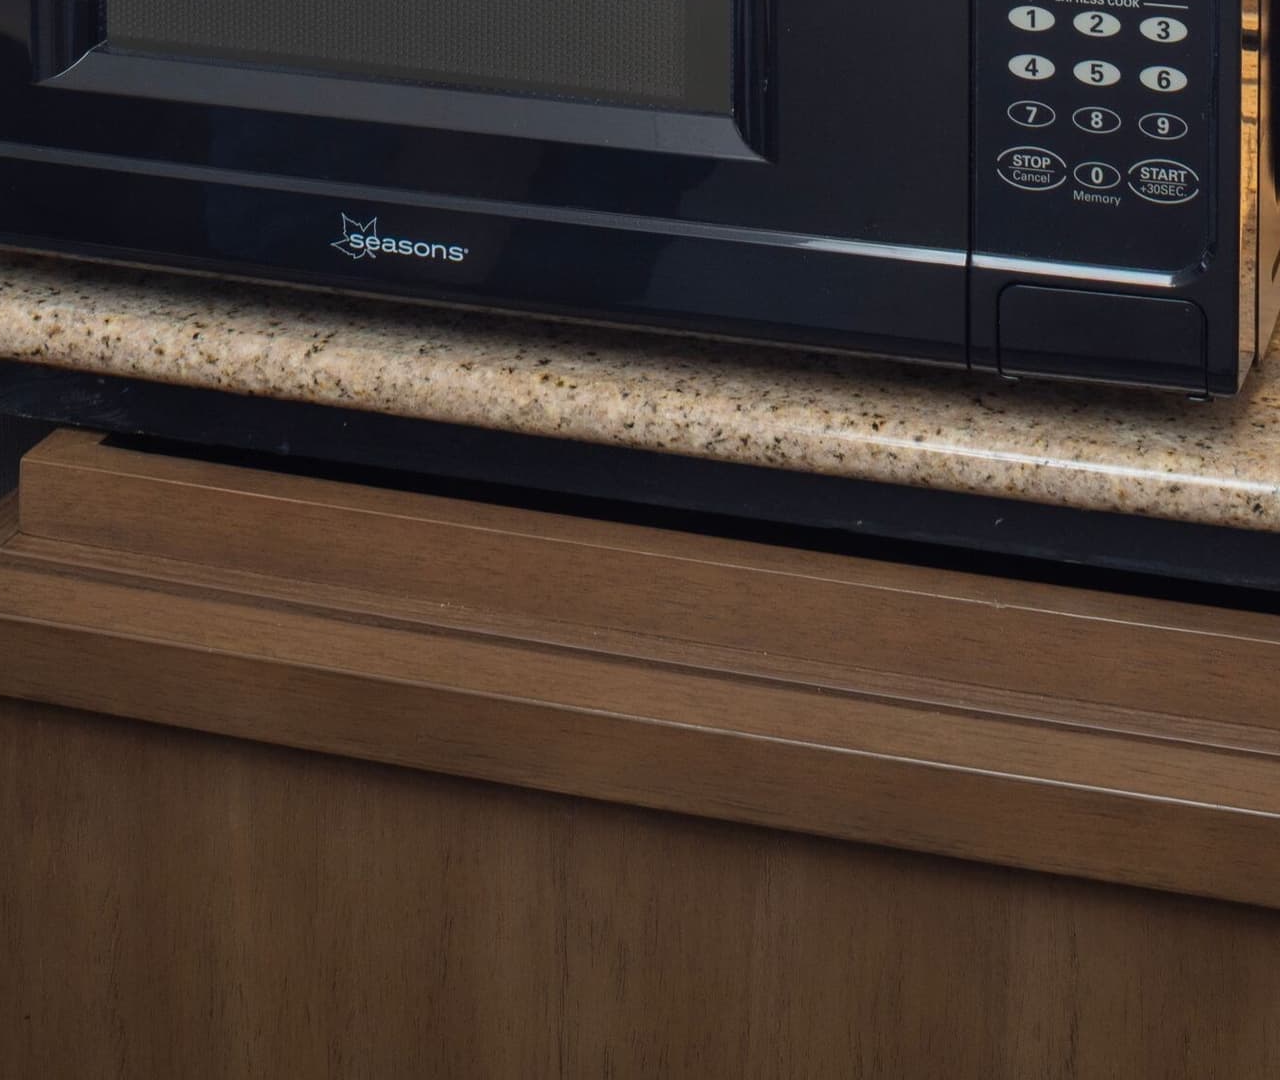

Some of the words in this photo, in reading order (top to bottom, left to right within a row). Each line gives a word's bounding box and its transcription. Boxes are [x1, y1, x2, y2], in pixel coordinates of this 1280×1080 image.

[1026, 9, 1036, 28] 1
[1090, 14, 1104, 33] 2
[1156, 20, 1170, 40] 3
[1025, 58, 1038, 77] 4
[1090, 63, 1104, 83] 5
[1157, 70, 1171, 90] 6
[1025, 106, 1037, 123] 7
[1091, 111, 1103, 128] 8
[1157, 117, 1169, 134] 9
[1013, 154, 1051, 169] STOP
[1012, 170, 1050, 183] Cancel
[1091, 167, 1103, 184] 0
[1140, 166, 1187, 183] START
[1074, 190, 1121, 206] Memory
[1140, 184, 1187, 197] +30SEC.
[349, 233, 464, 261] seasons
